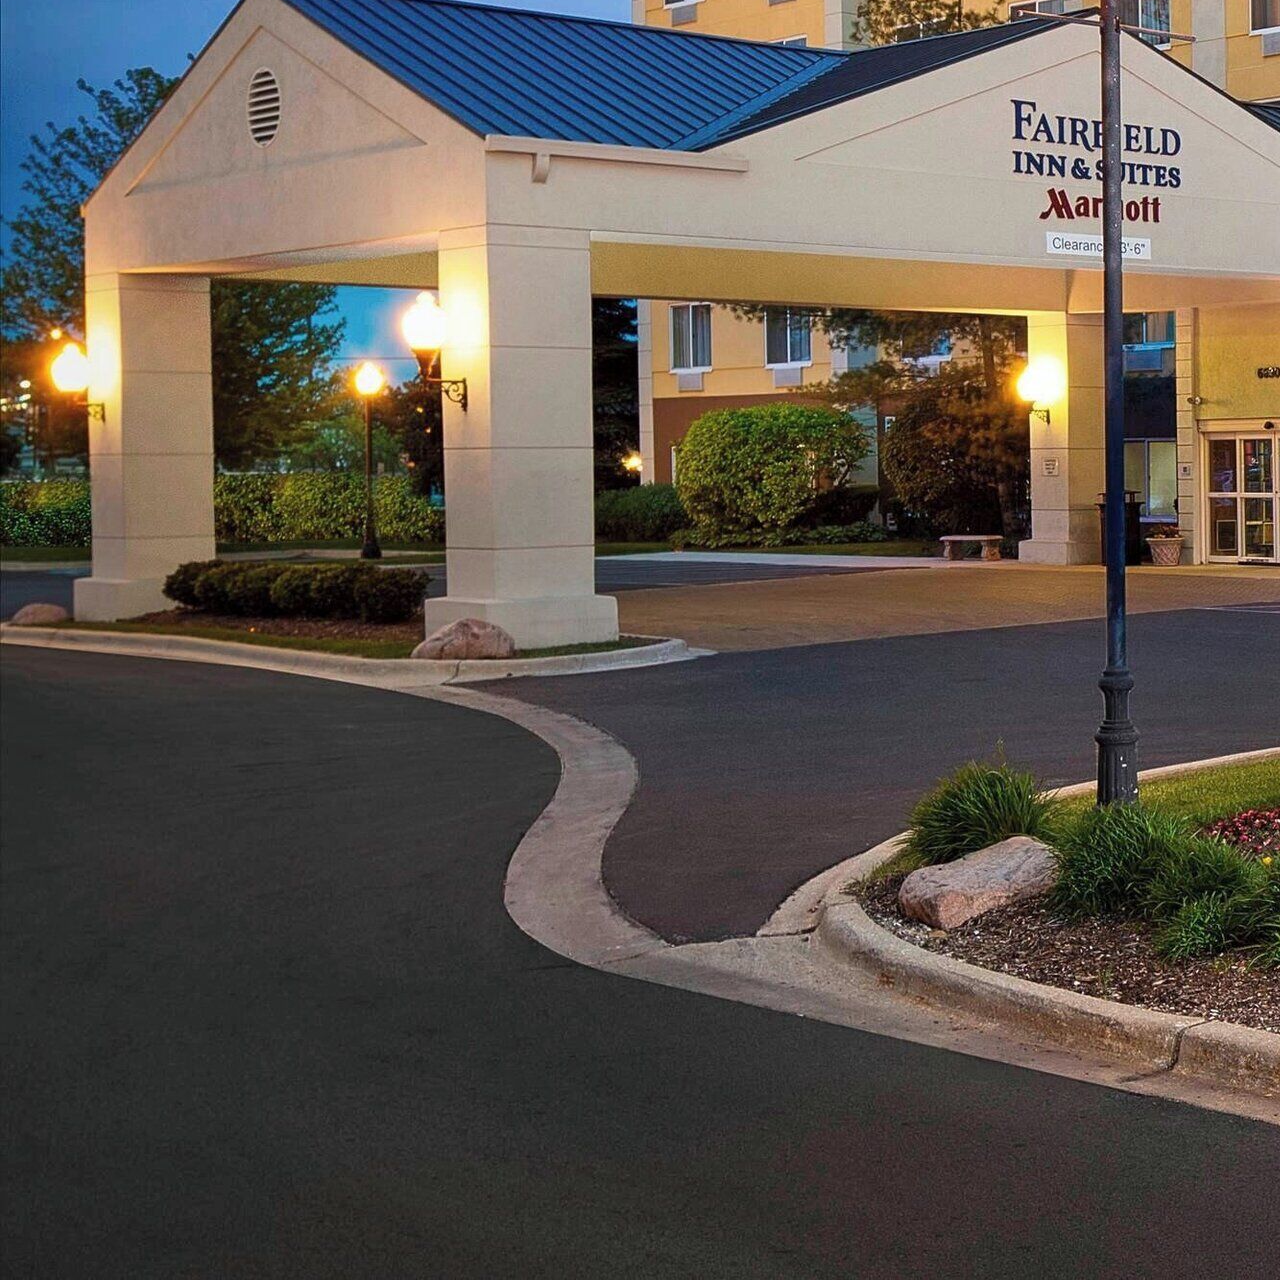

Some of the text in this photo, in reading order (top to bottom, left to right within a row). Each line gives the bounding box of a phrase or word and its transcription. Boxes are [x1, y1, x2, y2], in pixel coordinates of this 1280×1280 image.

[1010, 99, 1181, 156] FAIRFELD
[1012, 150, 1067, 179] INN
[1071, 158, 1092, 180] &
[1039, 187, 1161, 223] Marott
[1052, 236, 1104, 253] Clearanc
